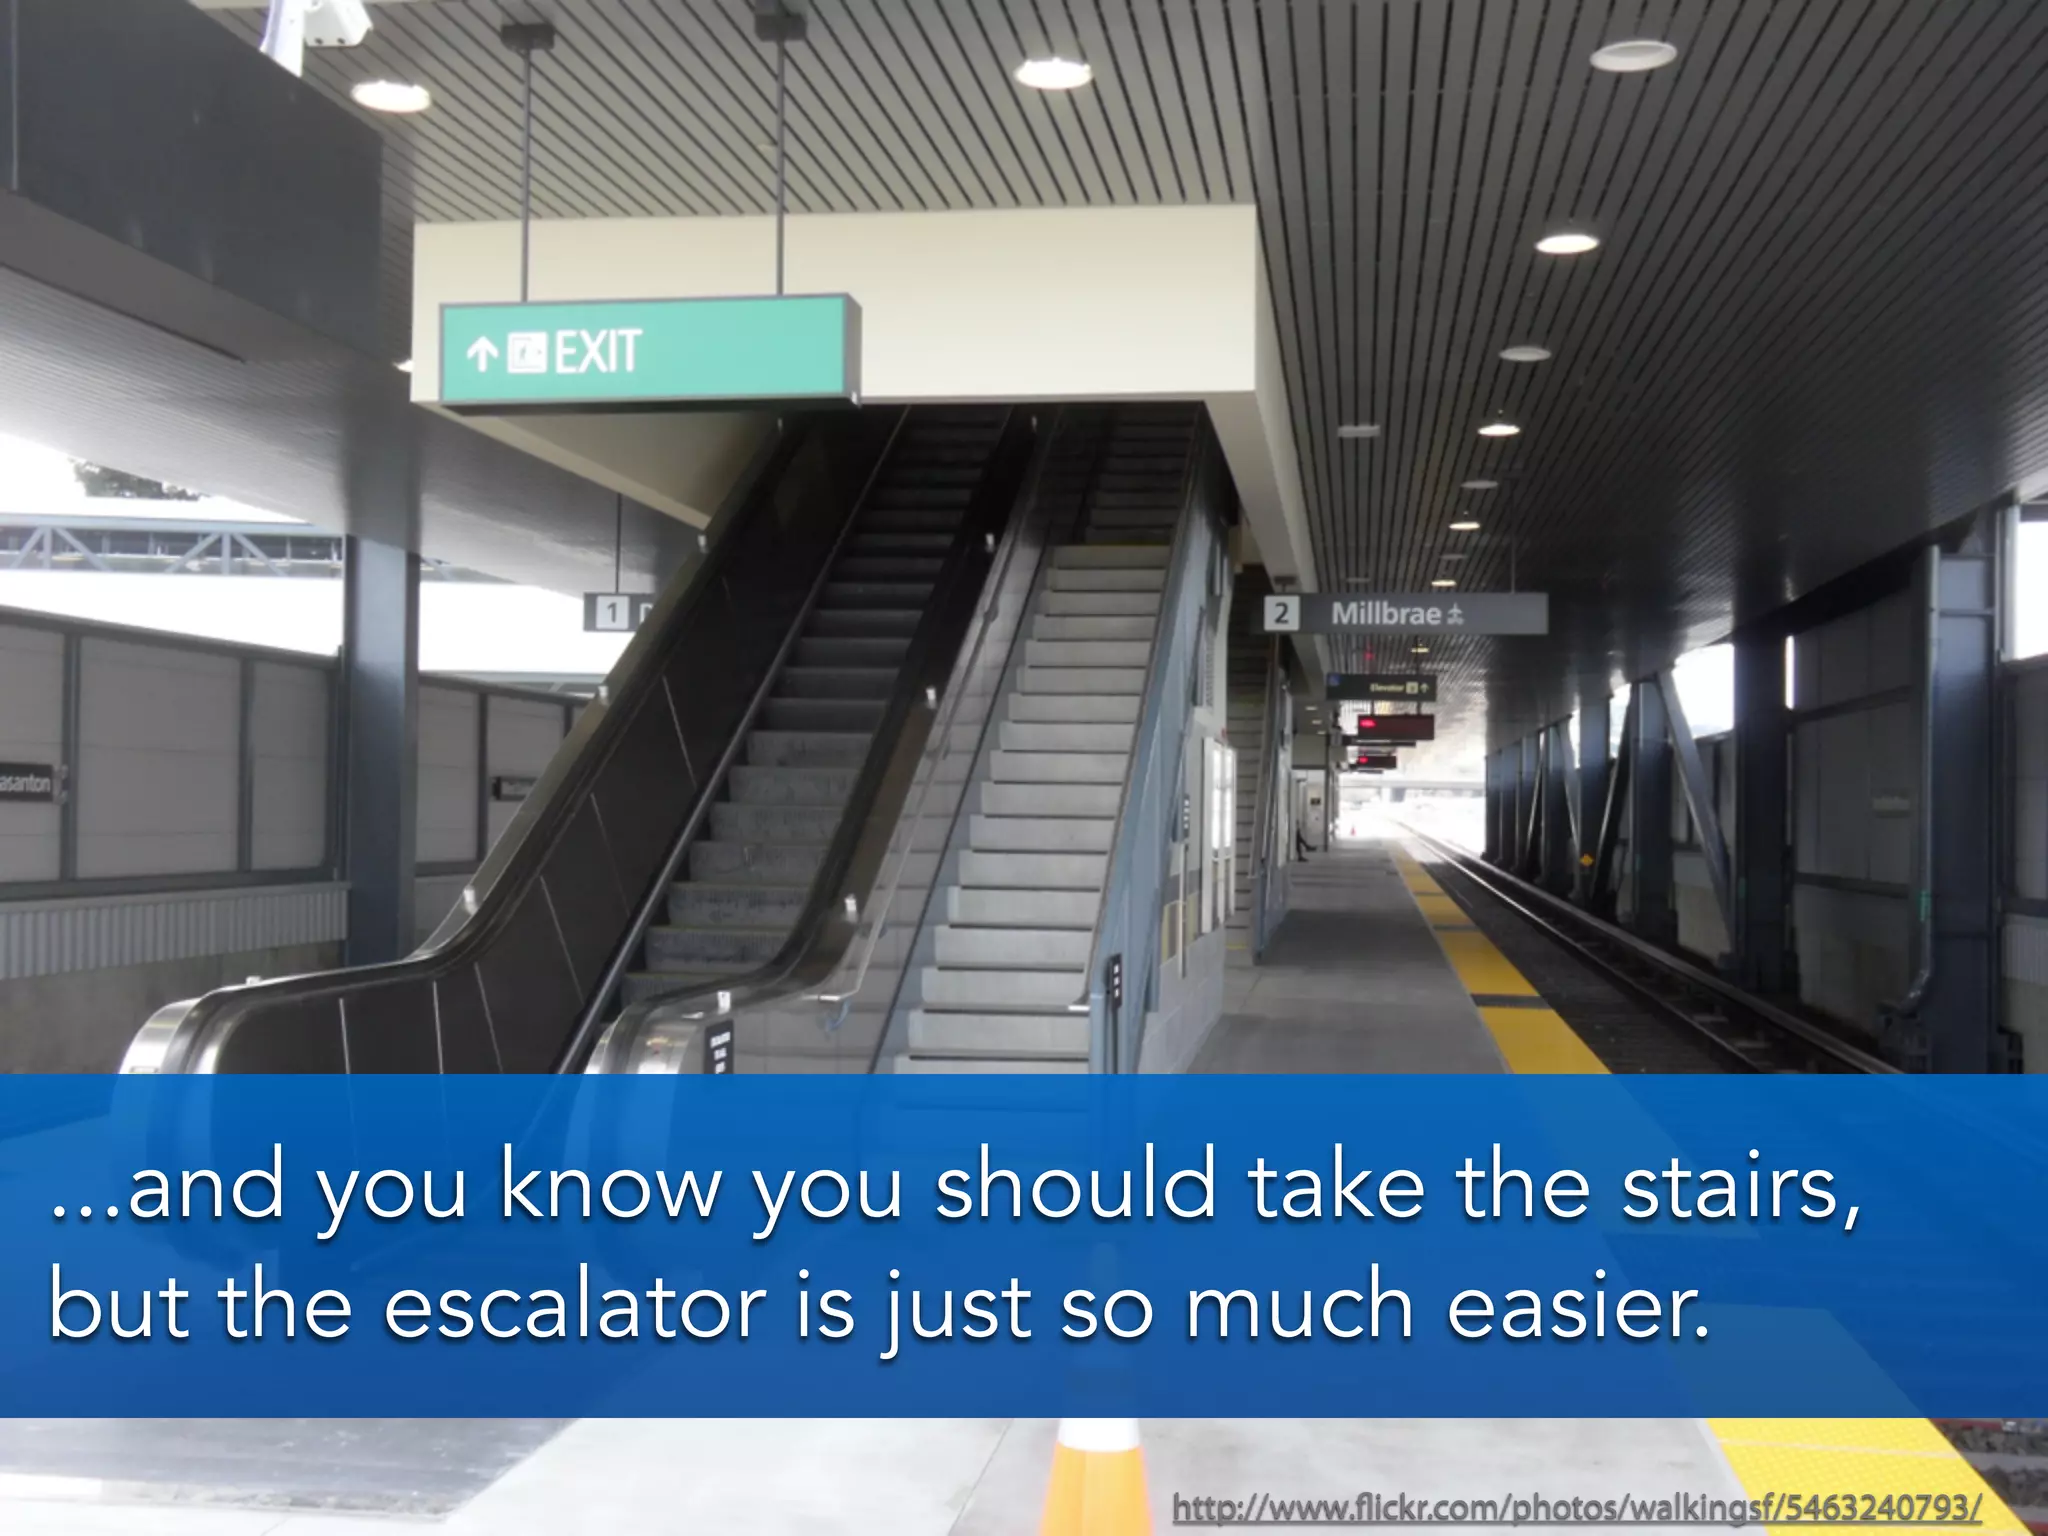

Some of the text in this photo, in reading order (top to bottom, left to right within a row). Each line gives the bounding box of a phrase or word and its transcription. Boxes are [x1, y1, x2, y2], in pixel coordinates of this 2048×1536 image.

[556, 329, 643, 374] EXIT
[606, 602, 617, 623] 1
[1274, 601, 1442, 626] 2 Millbrae
